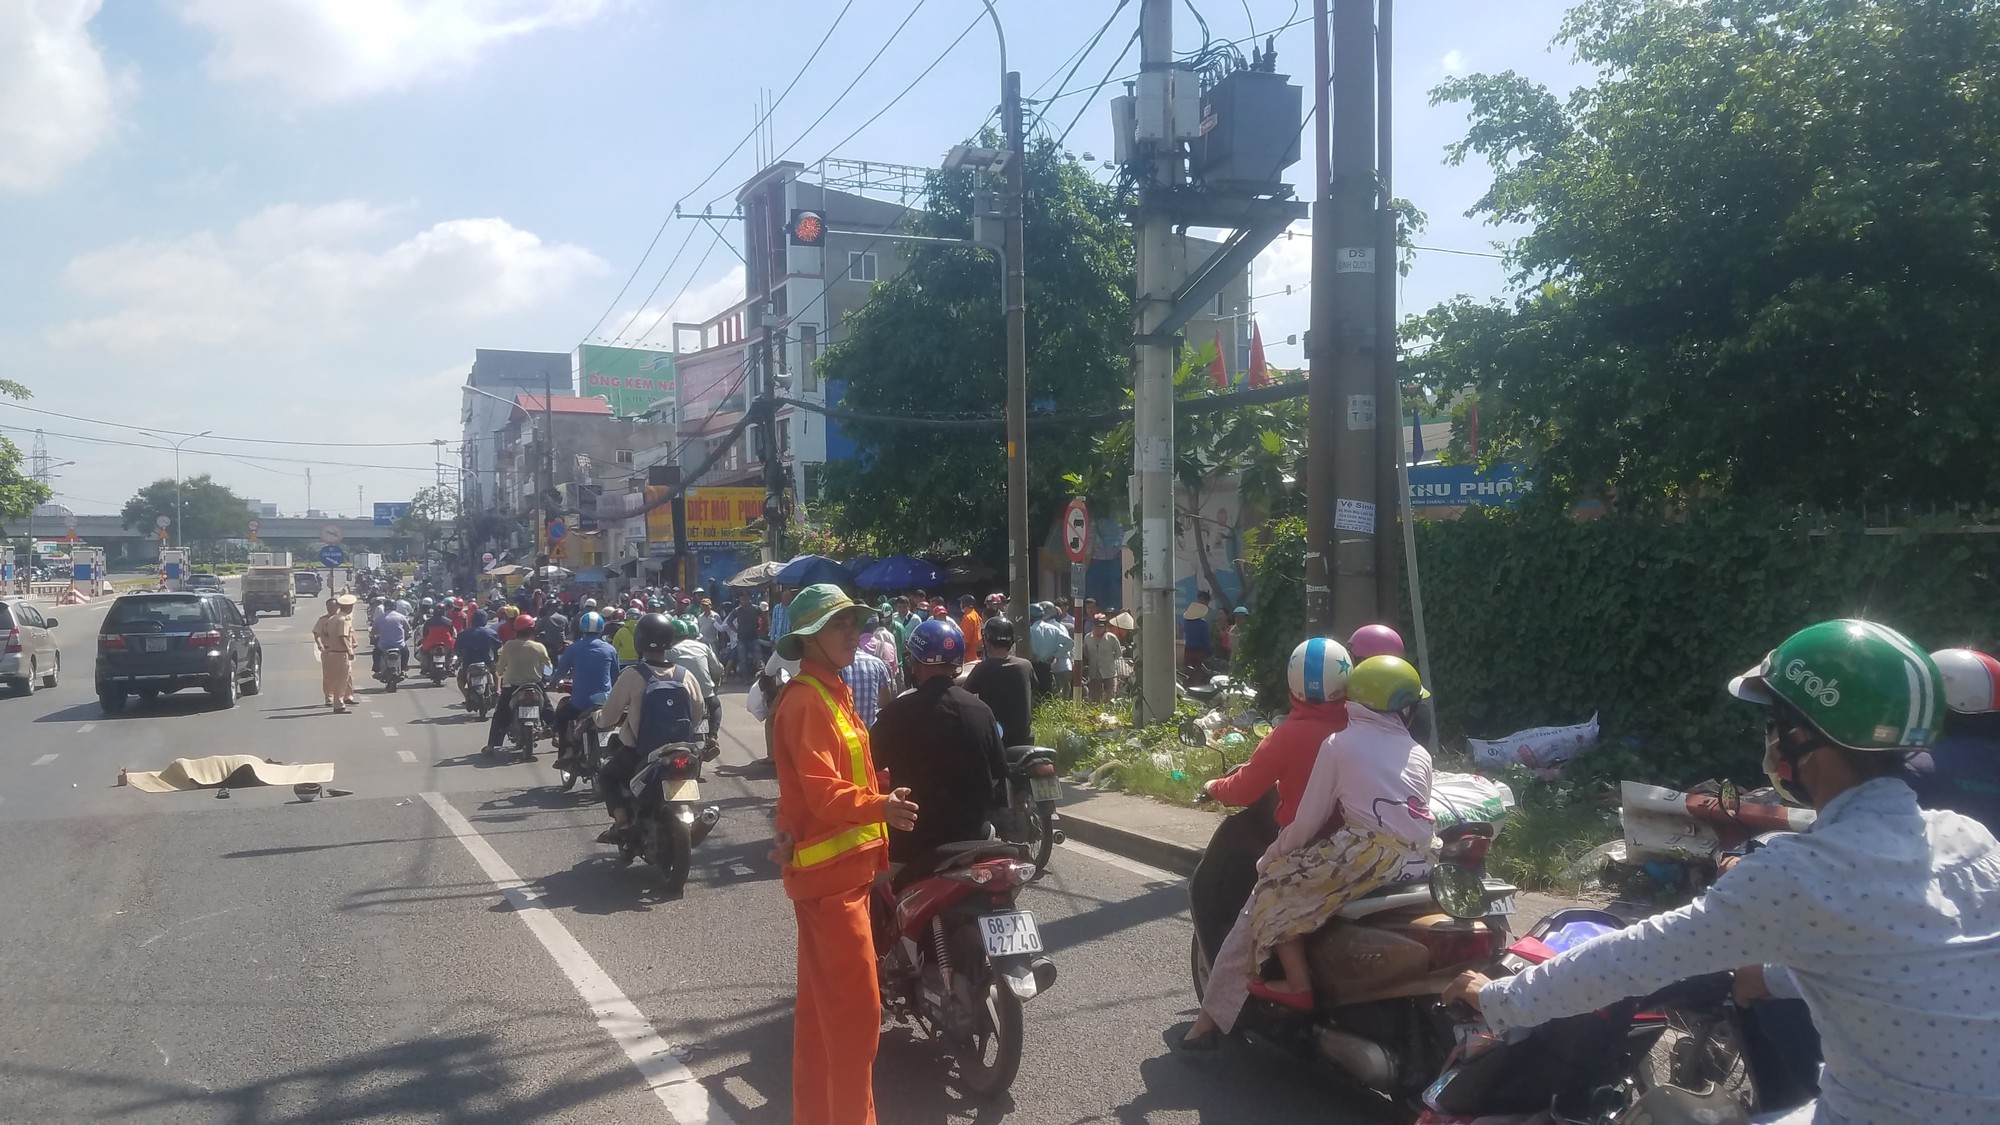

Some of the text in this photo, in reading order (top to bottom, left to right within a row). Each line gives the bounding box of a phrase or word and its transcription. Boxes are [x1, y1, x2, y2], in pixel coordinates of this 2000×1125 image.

[1349, 249, 1366, 258] DS
[658, 381, 675, 391] NA
[1460, 476, 1513, 496] PHỐ
[1785, 658, 1840, 707] Grab
[987, 915, 1027, 935] 68-X1
[989, 933, 1039, 954] 427.40
